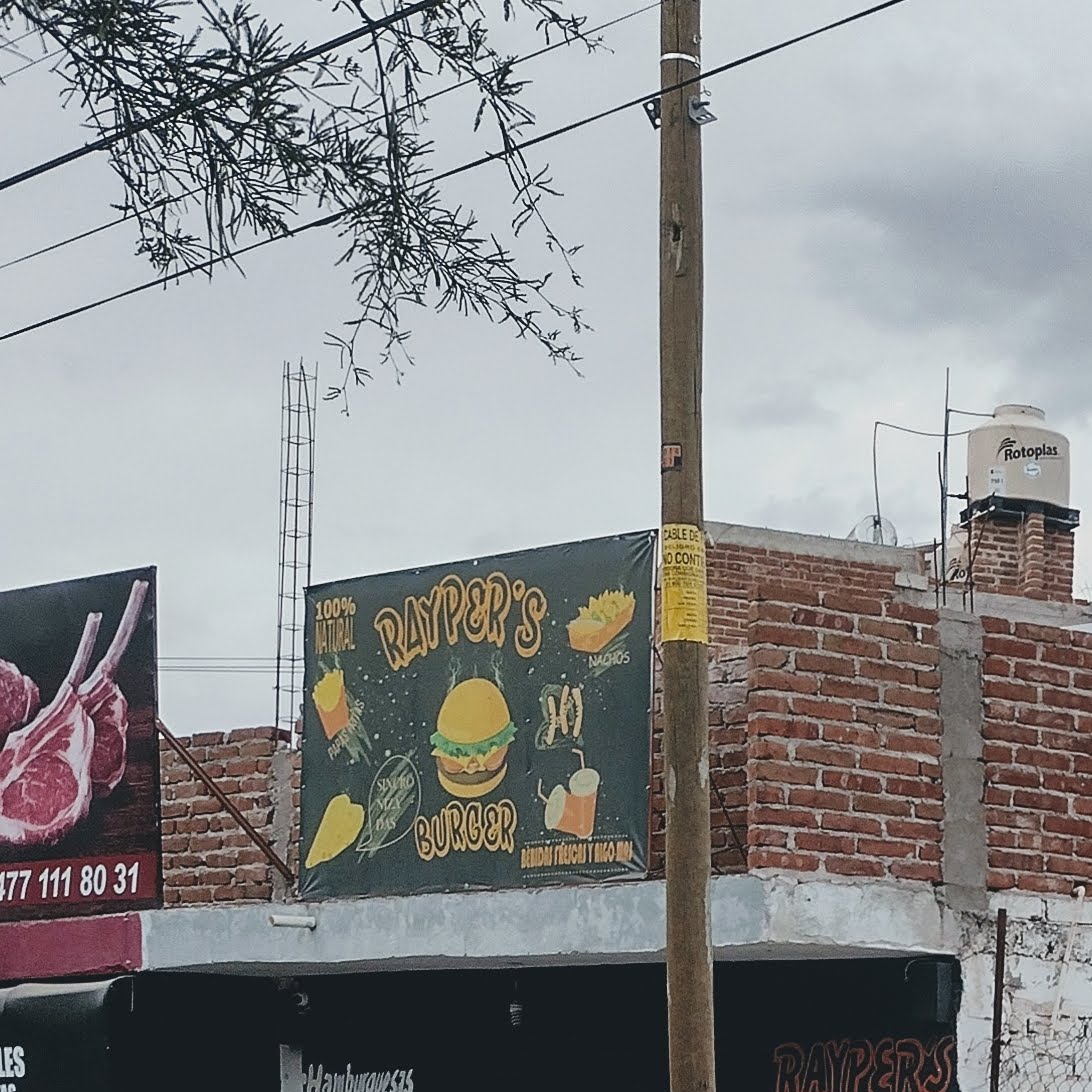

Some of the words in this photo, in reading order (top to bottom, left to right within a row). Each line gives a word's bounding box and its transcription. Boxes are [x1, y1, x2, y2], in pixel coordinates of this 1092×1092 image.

[1004, 443, 1058, 461] Rotoplas
[315, 596, 356, 620] 100%
[374, 571, 547, 671] RAYPER'S
[588, 651, 630, 668] NACHOS
[415, 799, 517, 861] BURGER
[588, 843, 595, 863] Y
[39, 866, 71, 898] 111
[80, 864, 107, 896] 80
[113, 862, 139, 894] 31
